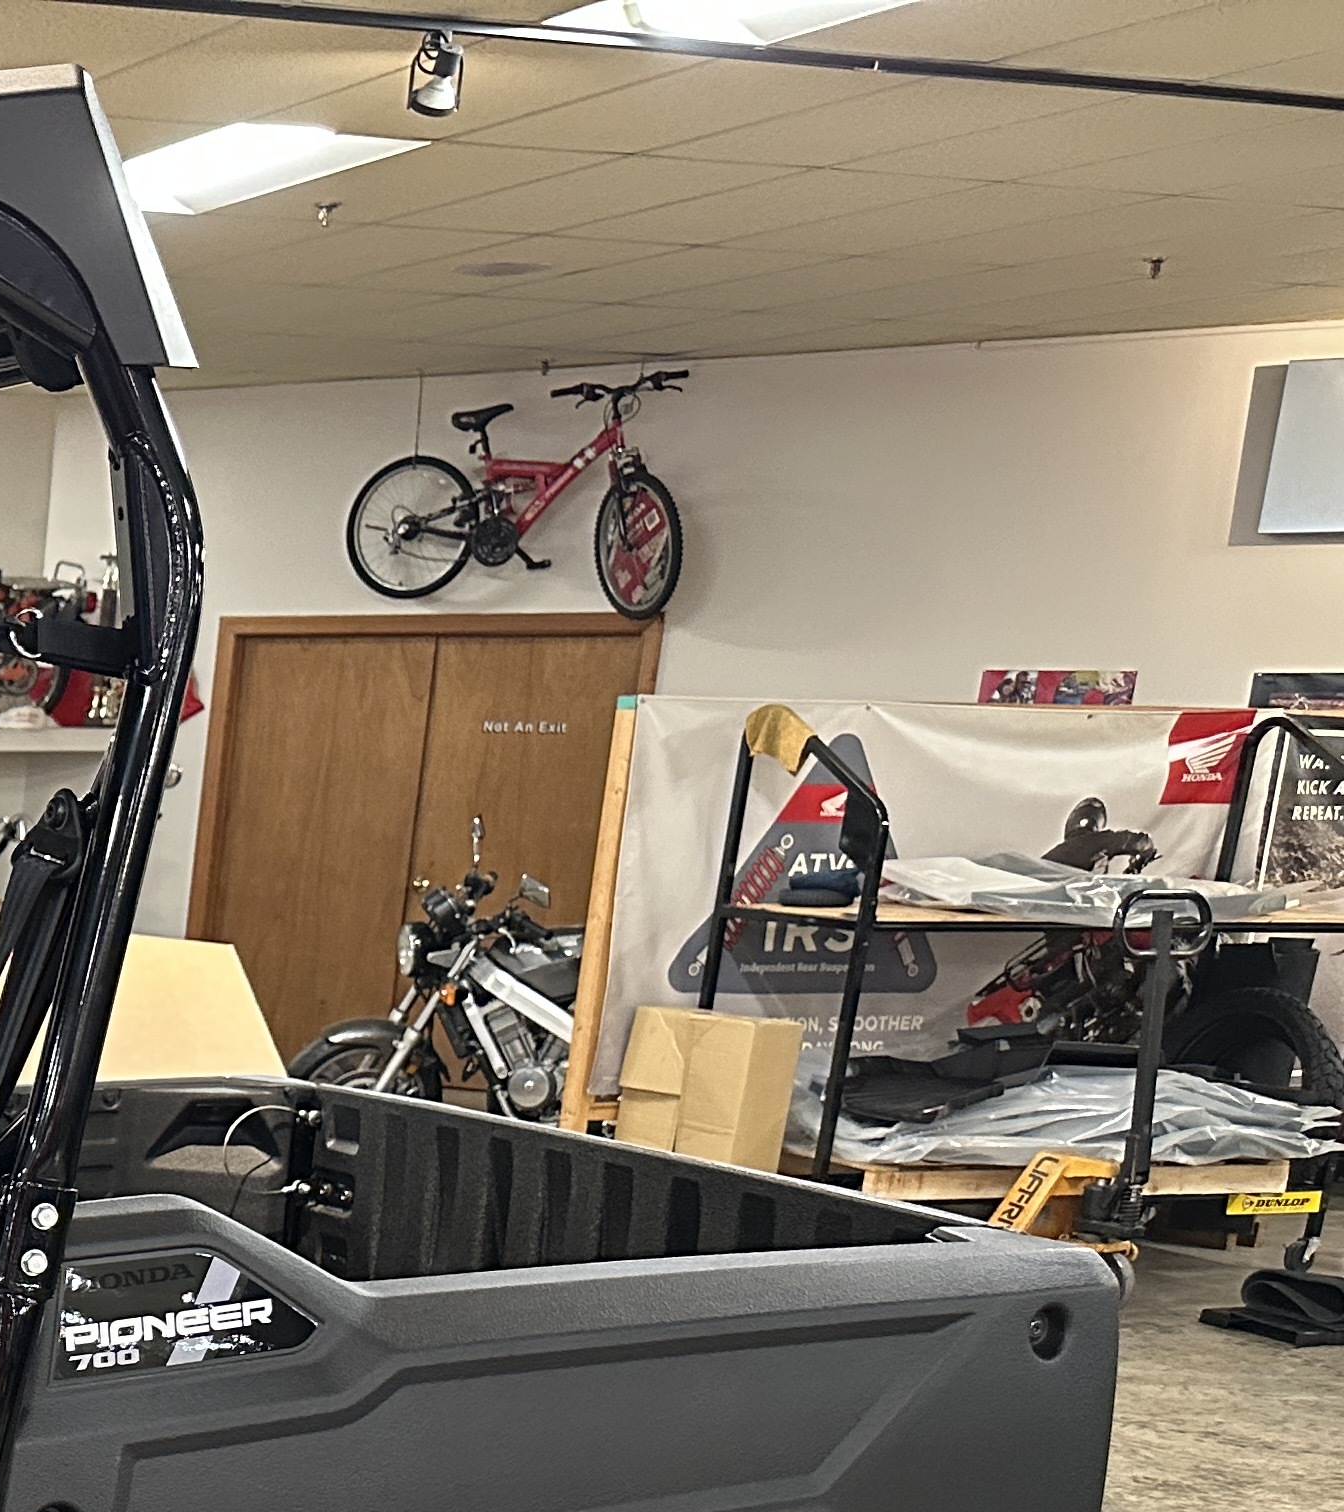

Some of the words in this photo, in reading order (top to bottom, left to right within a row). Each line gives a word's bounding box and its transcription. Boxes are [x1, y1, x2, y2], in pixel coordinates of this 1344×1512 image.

[483, 720, 509, 733] Not
[514, 720, 533, 733] An
[538, 720, 567, 734] Exit
[1181, 772, 1223, 783] HONDA
[1297, 780, 1332, 795] KICK
[1292, 806, 1344, 821] REPEAT.
[828, 1015, 924, 1033] SOOTHER
[997, 1155, 1060, 1230] LIFT-RI
[1255, 1198, 1310, 1208] DUNLOP
[64, 1298, 273, 1352] PIONEER
[68, 1349, 140, 1371] 700
